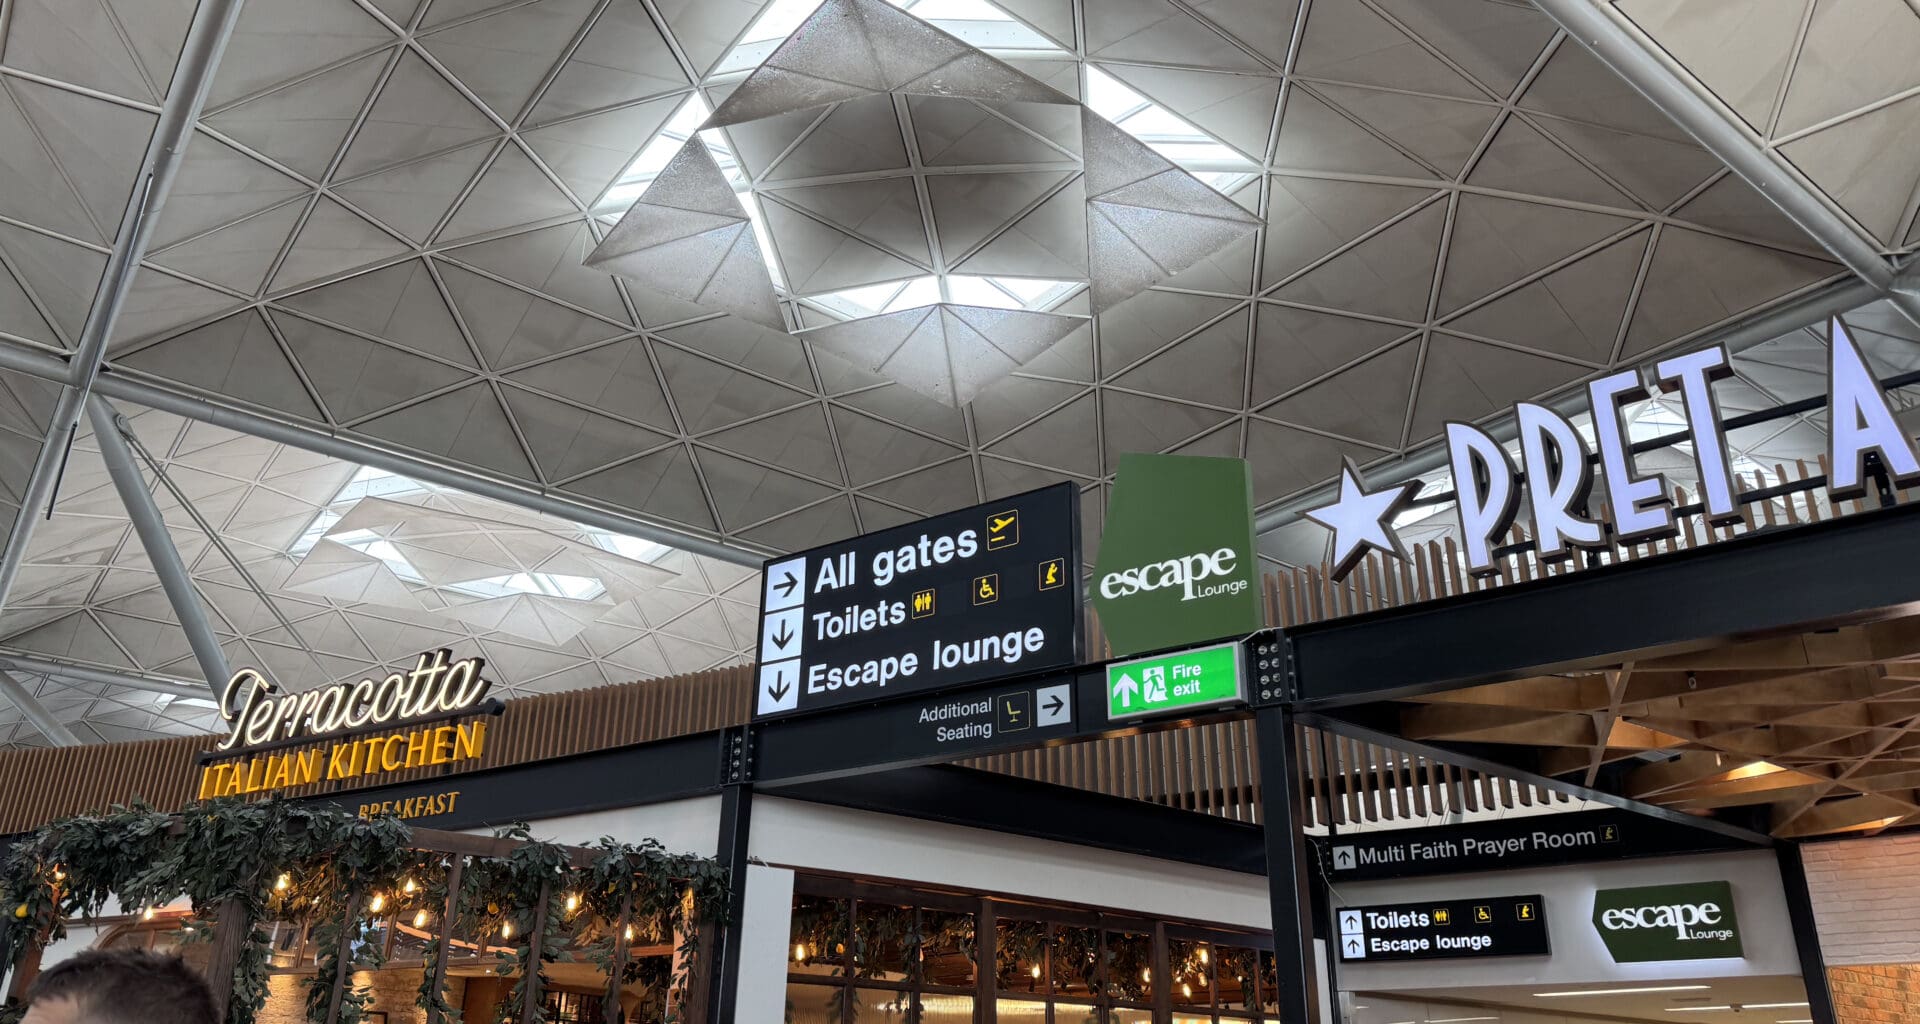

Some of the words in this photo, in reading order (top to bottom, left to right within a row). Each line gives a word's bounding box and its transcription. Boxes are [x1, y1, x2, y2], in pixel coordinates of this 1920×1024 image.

[1445, 342, 1733, 578] PRET
[1827, 313, 1920, 500] A
[813, 551, 856, 593] All
[872, 529, 978, 586] gates
[1100, 547, 1237, 602] escape
[1197, 579, 1248, 598] Lounge
[812, 599, 906, 641] Toilets
[807, 653, 919, 694] Escape
[933, 627, 1045, 671] lounge
[1172, 663, 1202, 679] Fire
[217, 649, 488, 749] Terracotta
[1173, 680, 1201, 696] exit
[919, 697, 993, 723] Additional
[936, 721, 993, 743] Seating
[199, 748, 325, 800] ITALIAN
[327, 721, 488, 780] KITCHEN
[359, 791, 460, 821] BREAKFAST
[1359, 844, 1405, 864] Multi
[1410, 840, 1459, 860] Faith
[1463, 834, 1529, 860] Prayer
[1532, 827, 1597, 850] Room
[1366, 910, 1430, 930] Toilets
[1601, 898, 1722, 941] escape
[1689, 927, 1733, 942] Lounge
[1371, 935, 1430, 954] Escape
[1436, 932, 1492, 951] lounge
